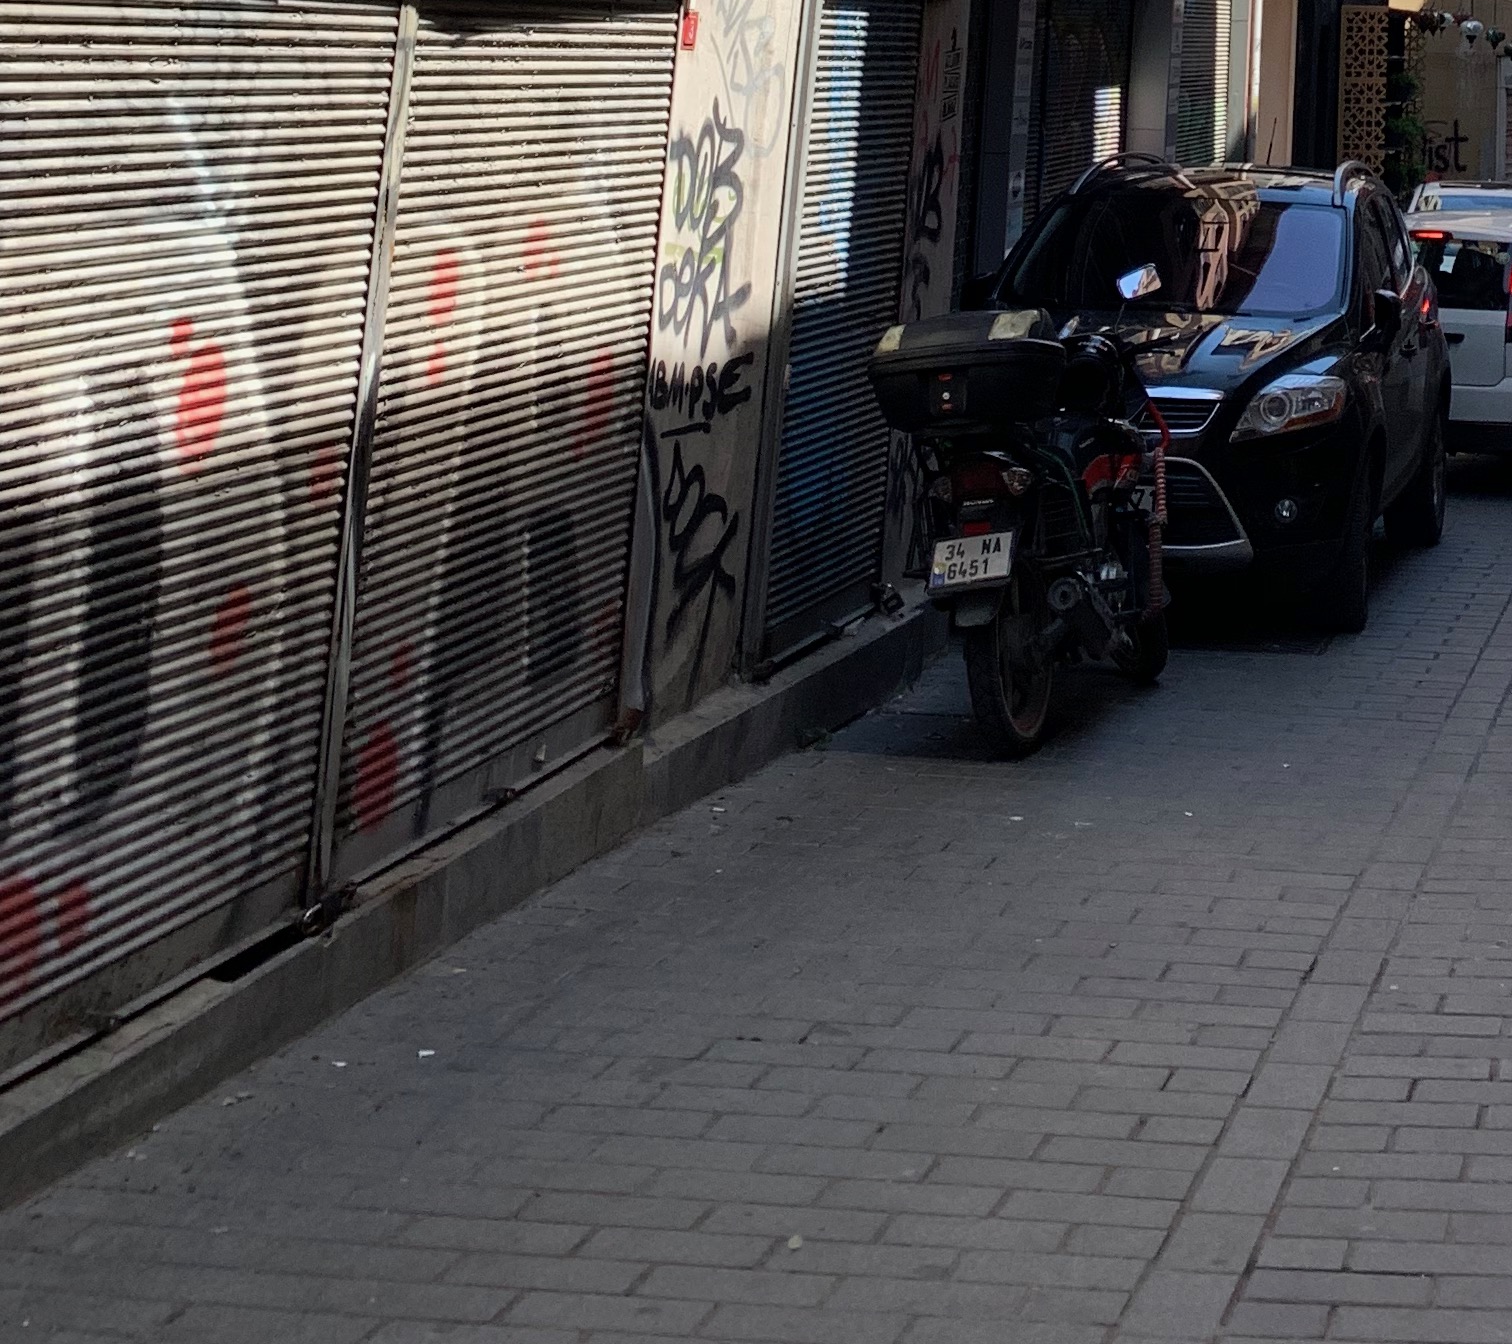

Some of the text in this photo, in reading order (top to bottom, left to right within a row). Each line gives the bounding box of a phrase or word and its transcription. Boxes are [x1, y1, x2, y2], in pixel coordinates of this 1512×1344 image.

[945, 537, 1002, 562] 34 NA
[947, 559, 988, 580] 6451
